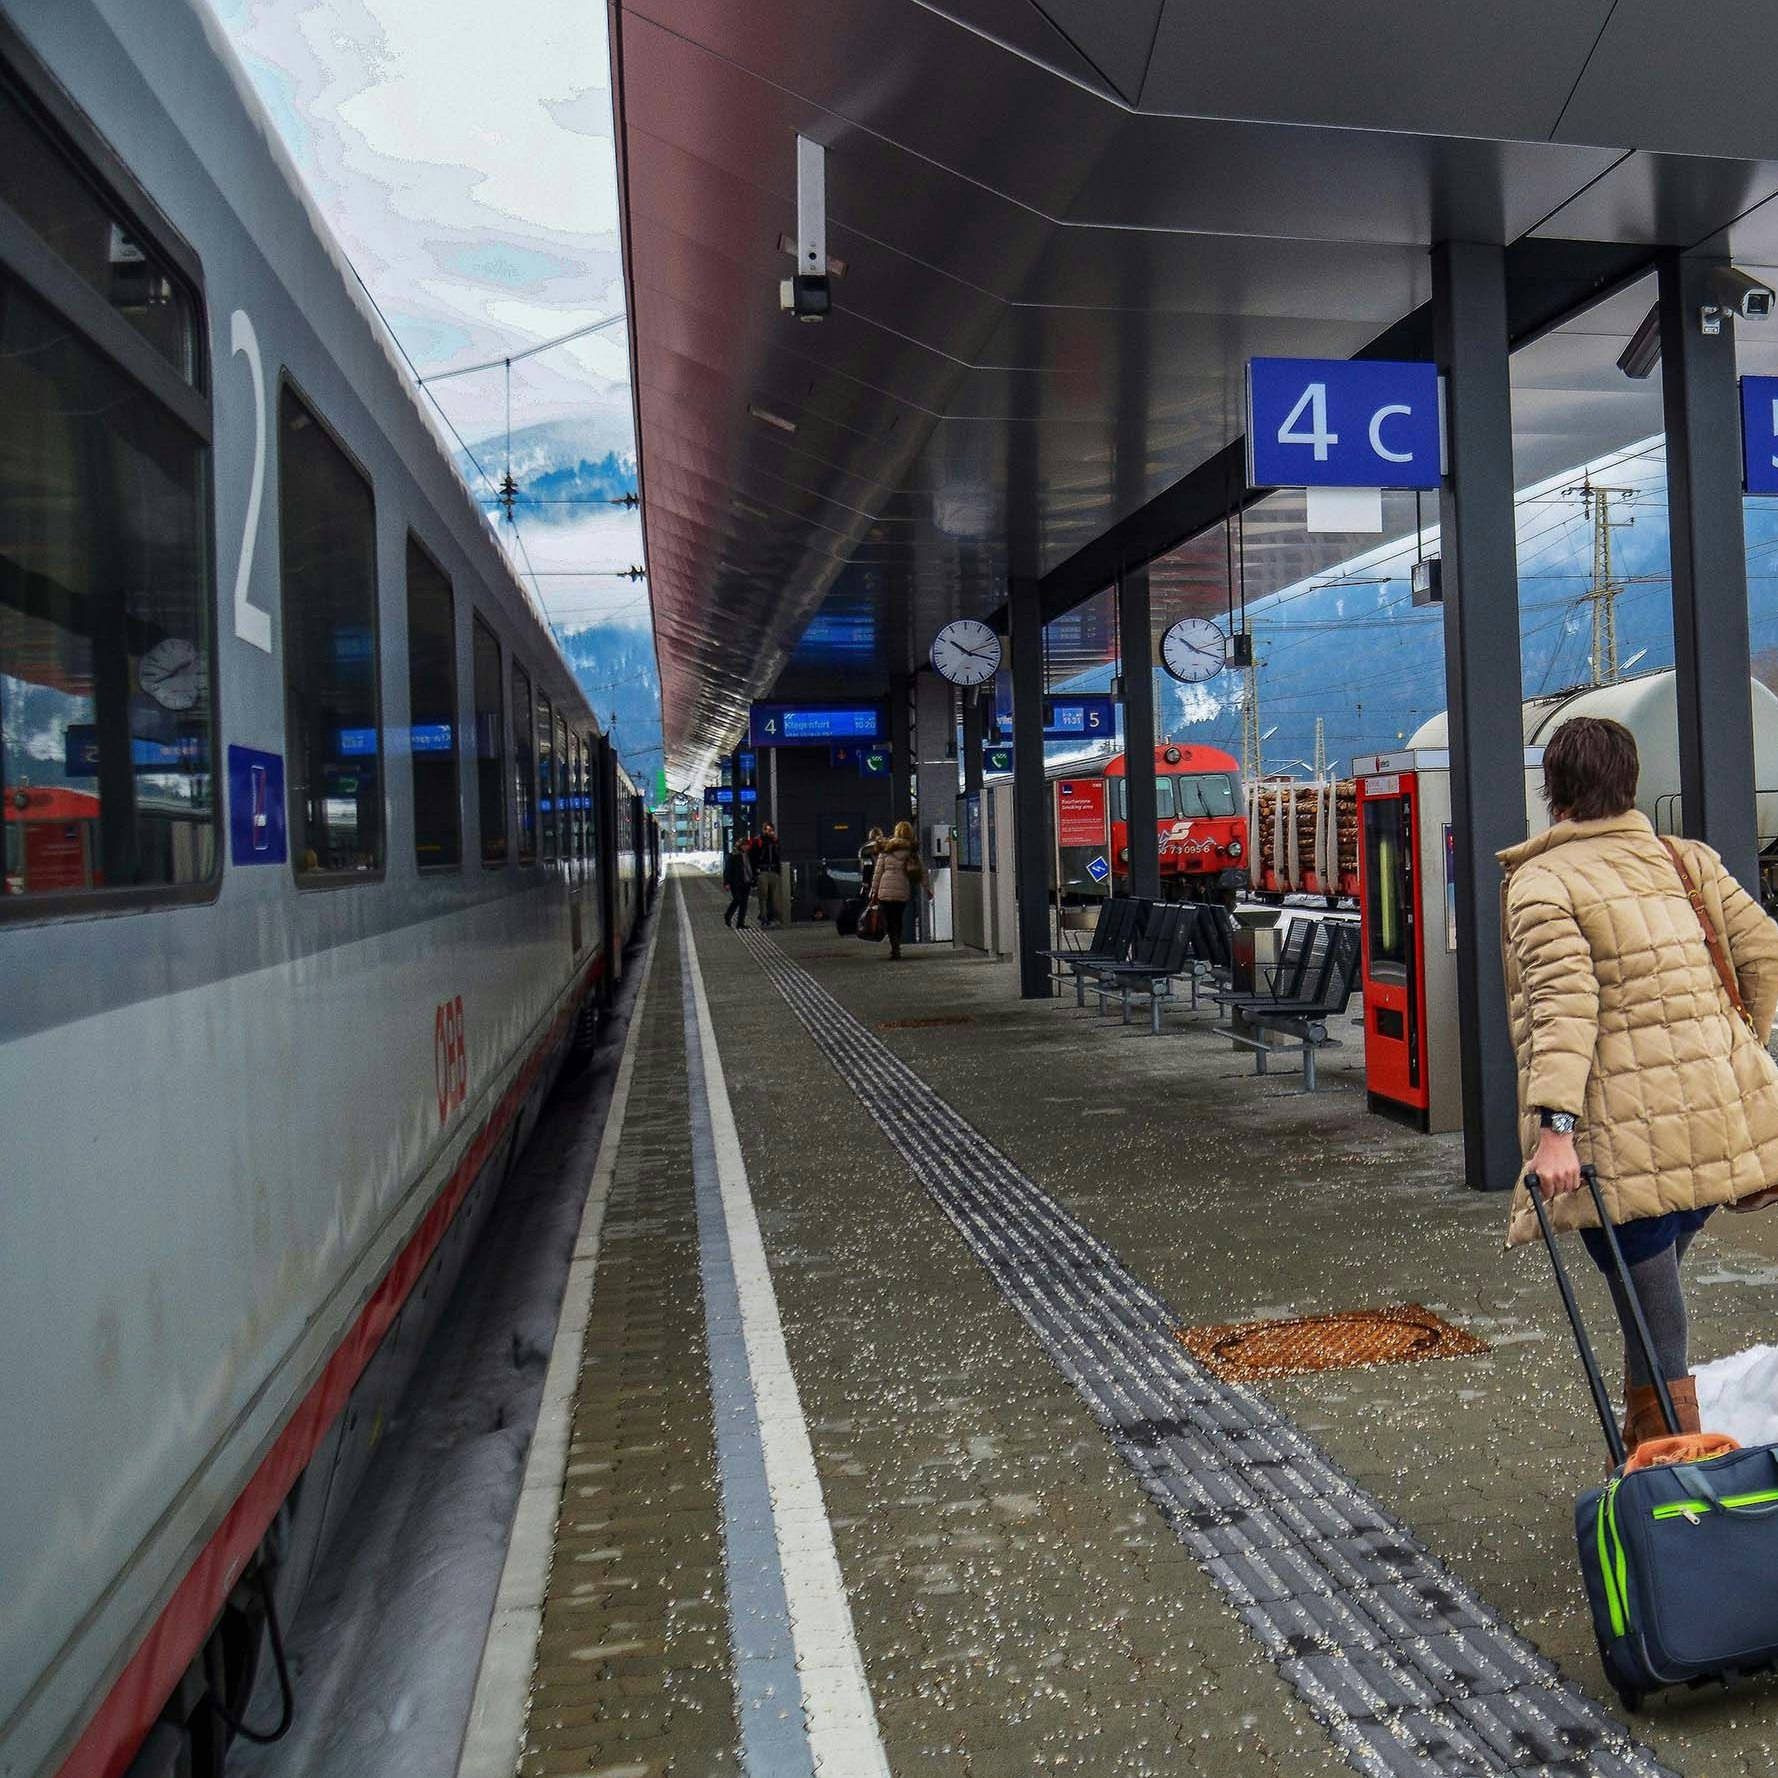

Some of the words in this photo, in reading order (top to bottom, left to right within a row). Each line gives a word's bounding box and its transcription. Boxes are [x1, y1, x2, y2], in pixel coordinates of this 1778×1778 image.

[1277, 383, 1339, 461] 4
[1368, 404, 1414, 463] c
[231, 309, 272, 654] 2
[764, 719, 777, 735] 4
[1089, 712, 1100, 728] 5
[434, 994, 467, 1124] ÖBB
